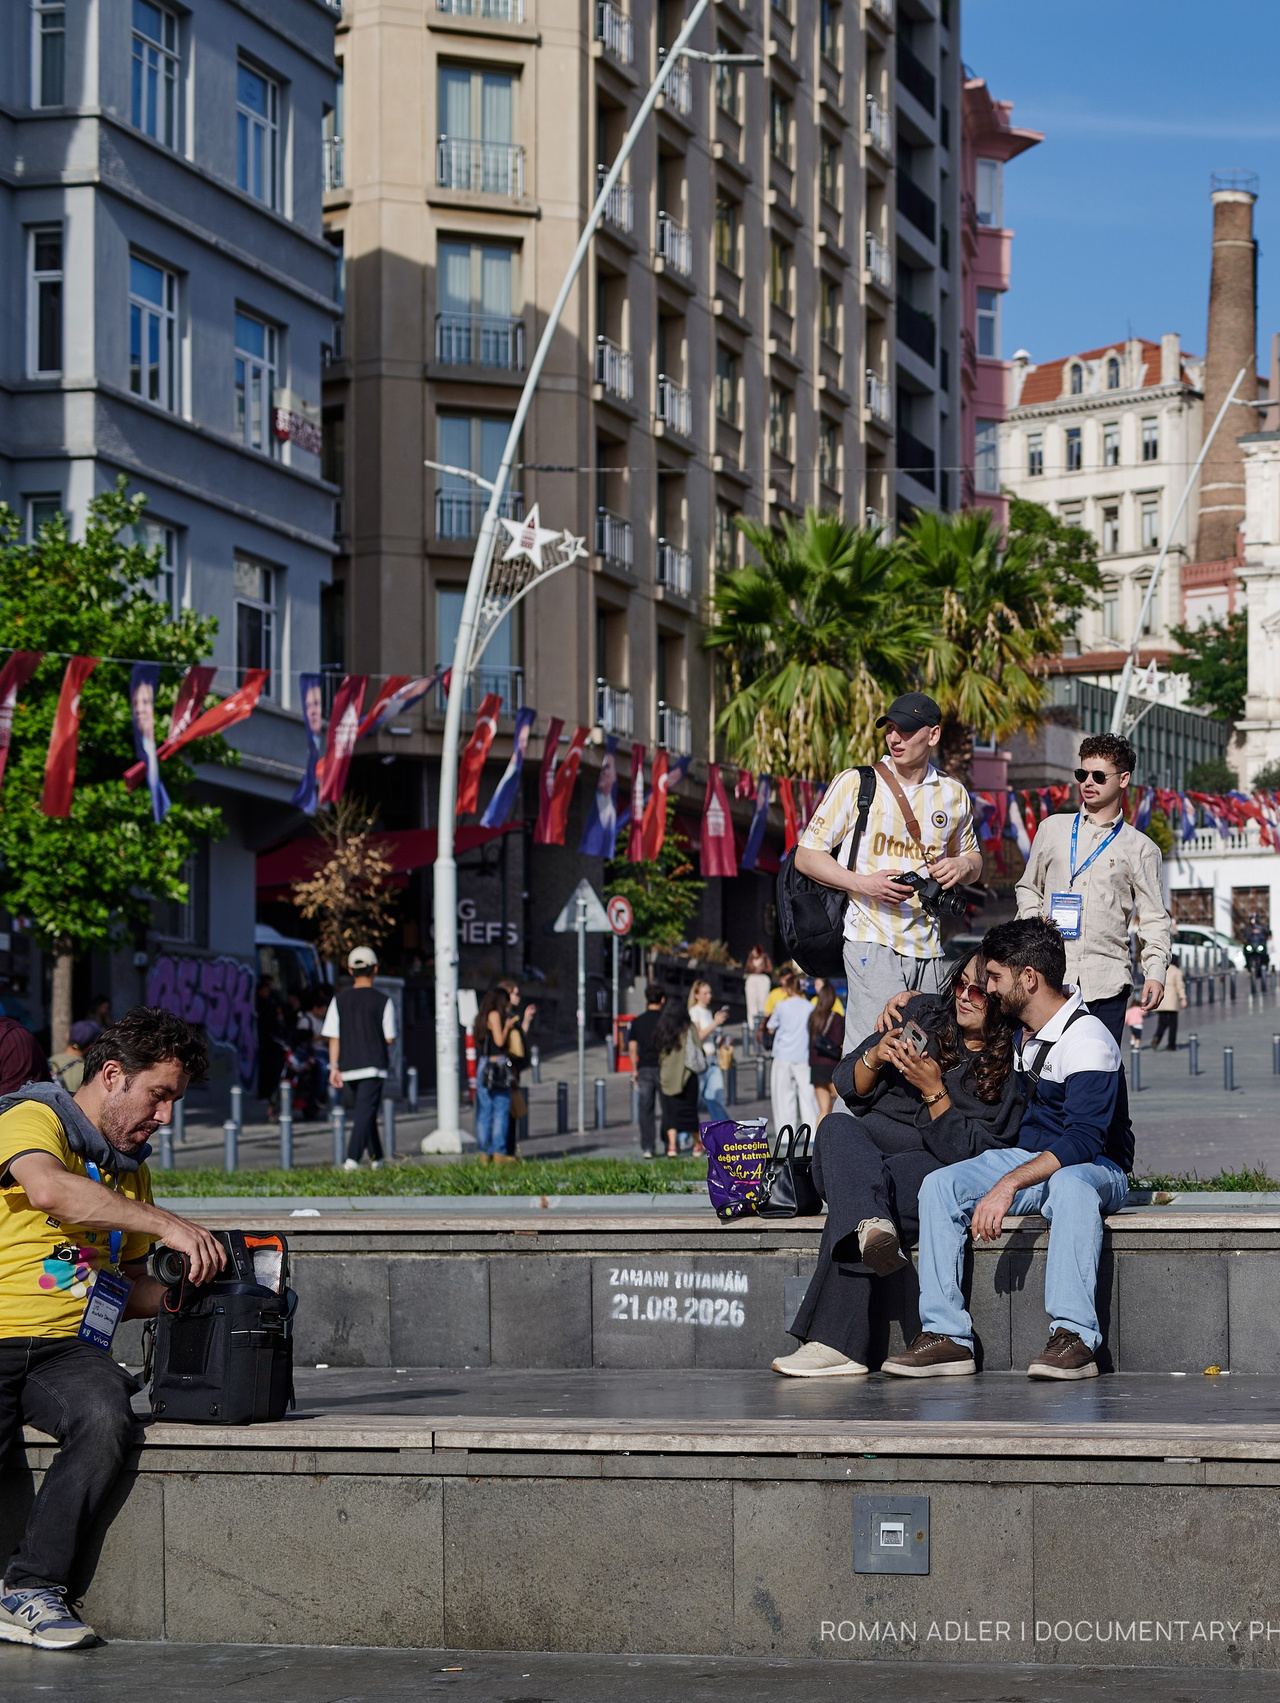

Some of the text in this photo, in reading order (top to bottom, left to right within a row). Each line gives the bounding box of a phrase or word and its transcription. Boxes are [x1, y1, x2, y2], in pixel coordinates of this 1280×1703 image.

[430, 921, 519, 945] HEFS
[718, 1153, 740, 1163] değer
[609, 1268, 669, 1288] ZAMANI
[611, 1293, 746, 1327] 21.08.2026
[93, 1335, 109, 1347] vivo
